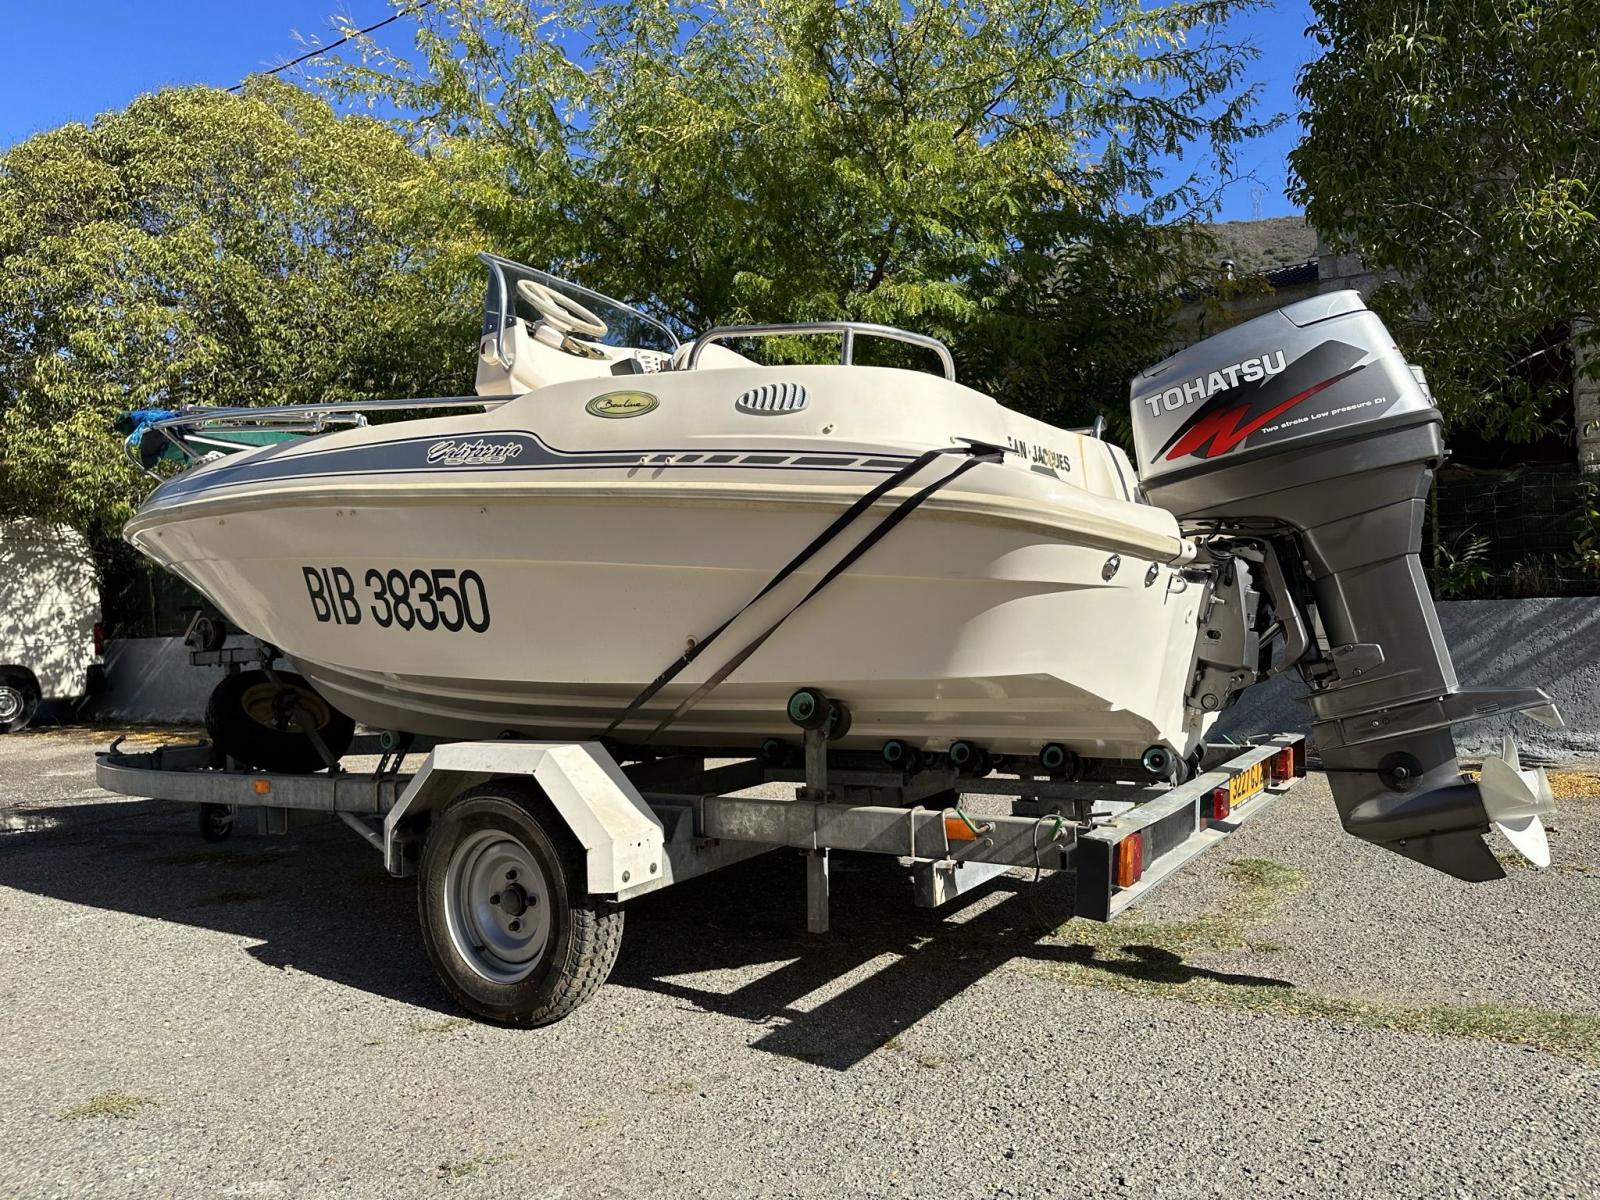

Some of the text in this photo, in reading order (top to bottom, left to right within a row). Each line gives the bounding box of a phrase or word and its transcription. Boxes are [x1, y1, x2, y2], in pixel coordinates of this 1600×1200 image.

[1145, 349, 1288, 417] TOHATSU
[1261, 425, 1279, 434] Two
[1281, 417, 1309, 429] stroke
[1310, 410, 1329, 420] Low
[1331, 400, 1372, 416] pressure
[427, 439, 523, 464] California
[302, 566, 491, 633] BIB 38350
[1232, 769, 1250, 800] 3227
